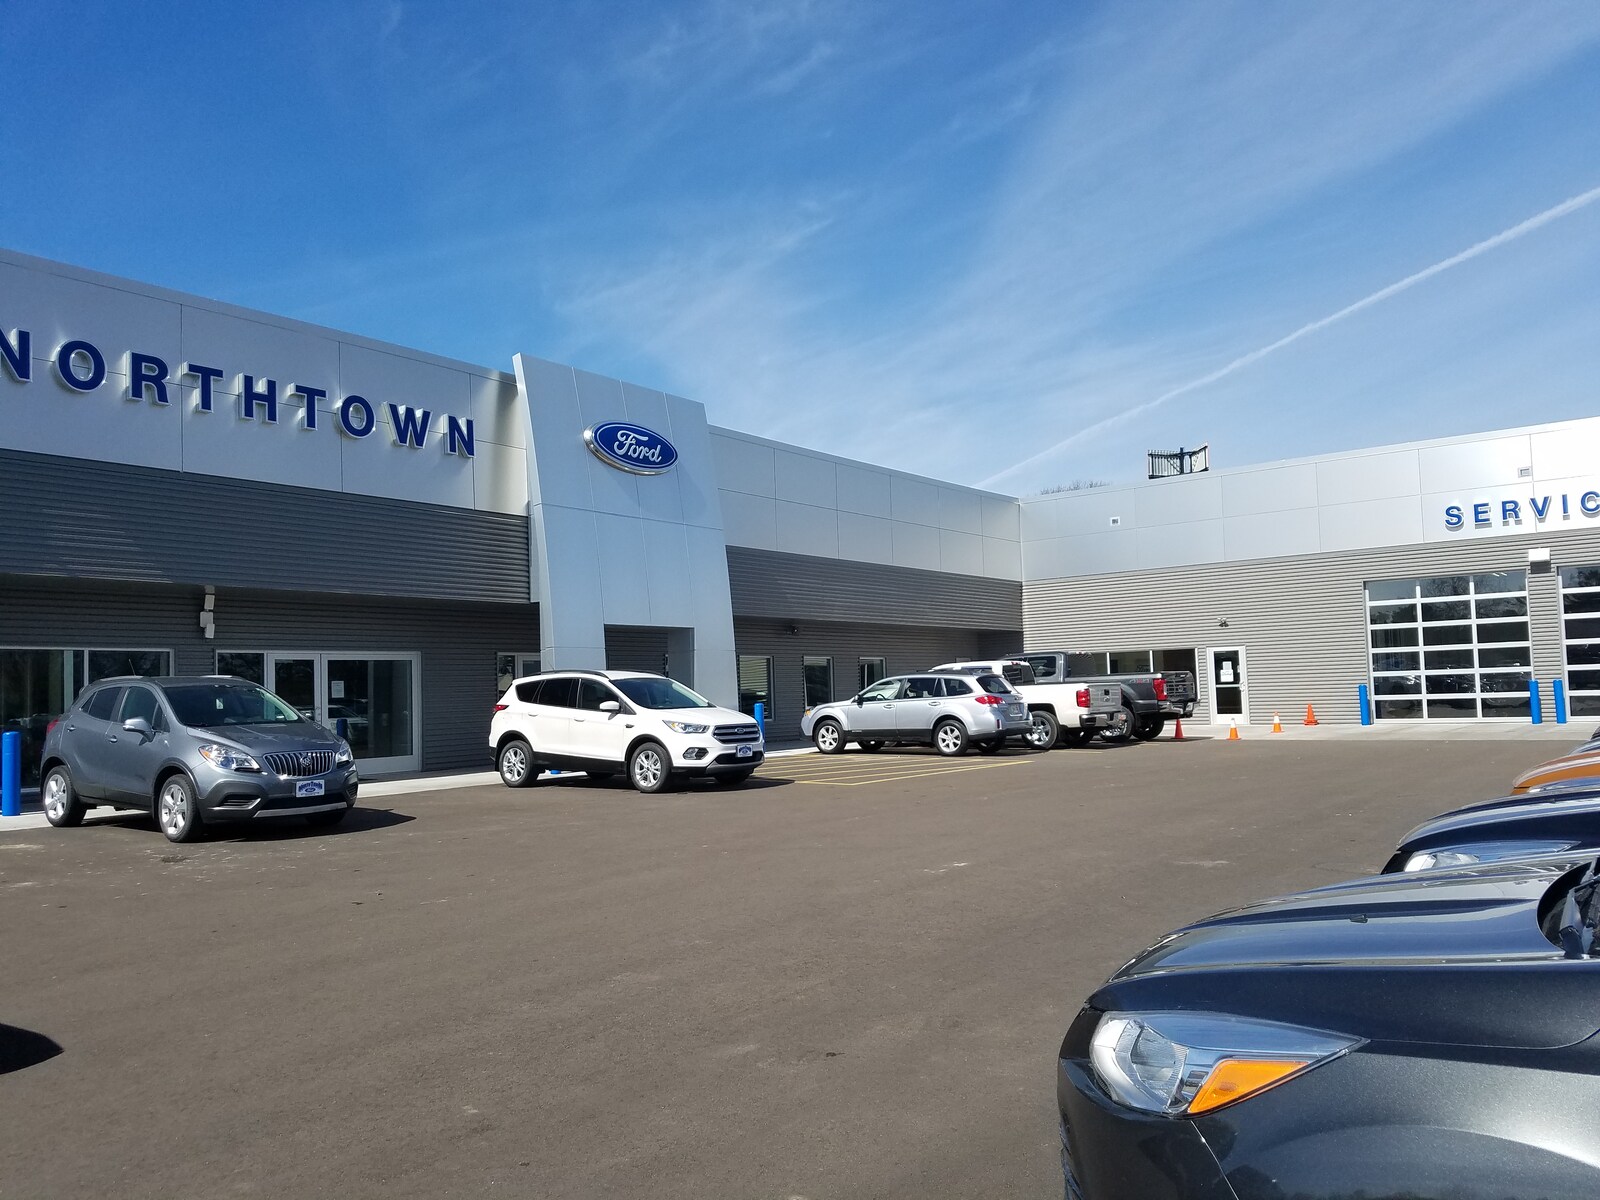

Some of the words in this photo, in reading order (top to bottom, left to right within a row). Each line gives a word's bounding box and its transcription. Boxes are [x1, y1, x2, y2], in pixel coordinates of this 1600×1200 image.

[0, 328, 475, 457] NORTHTOWN
[613, 430, 662, 463] Ford
[1445, 491, 1600, 526] SERVIC
